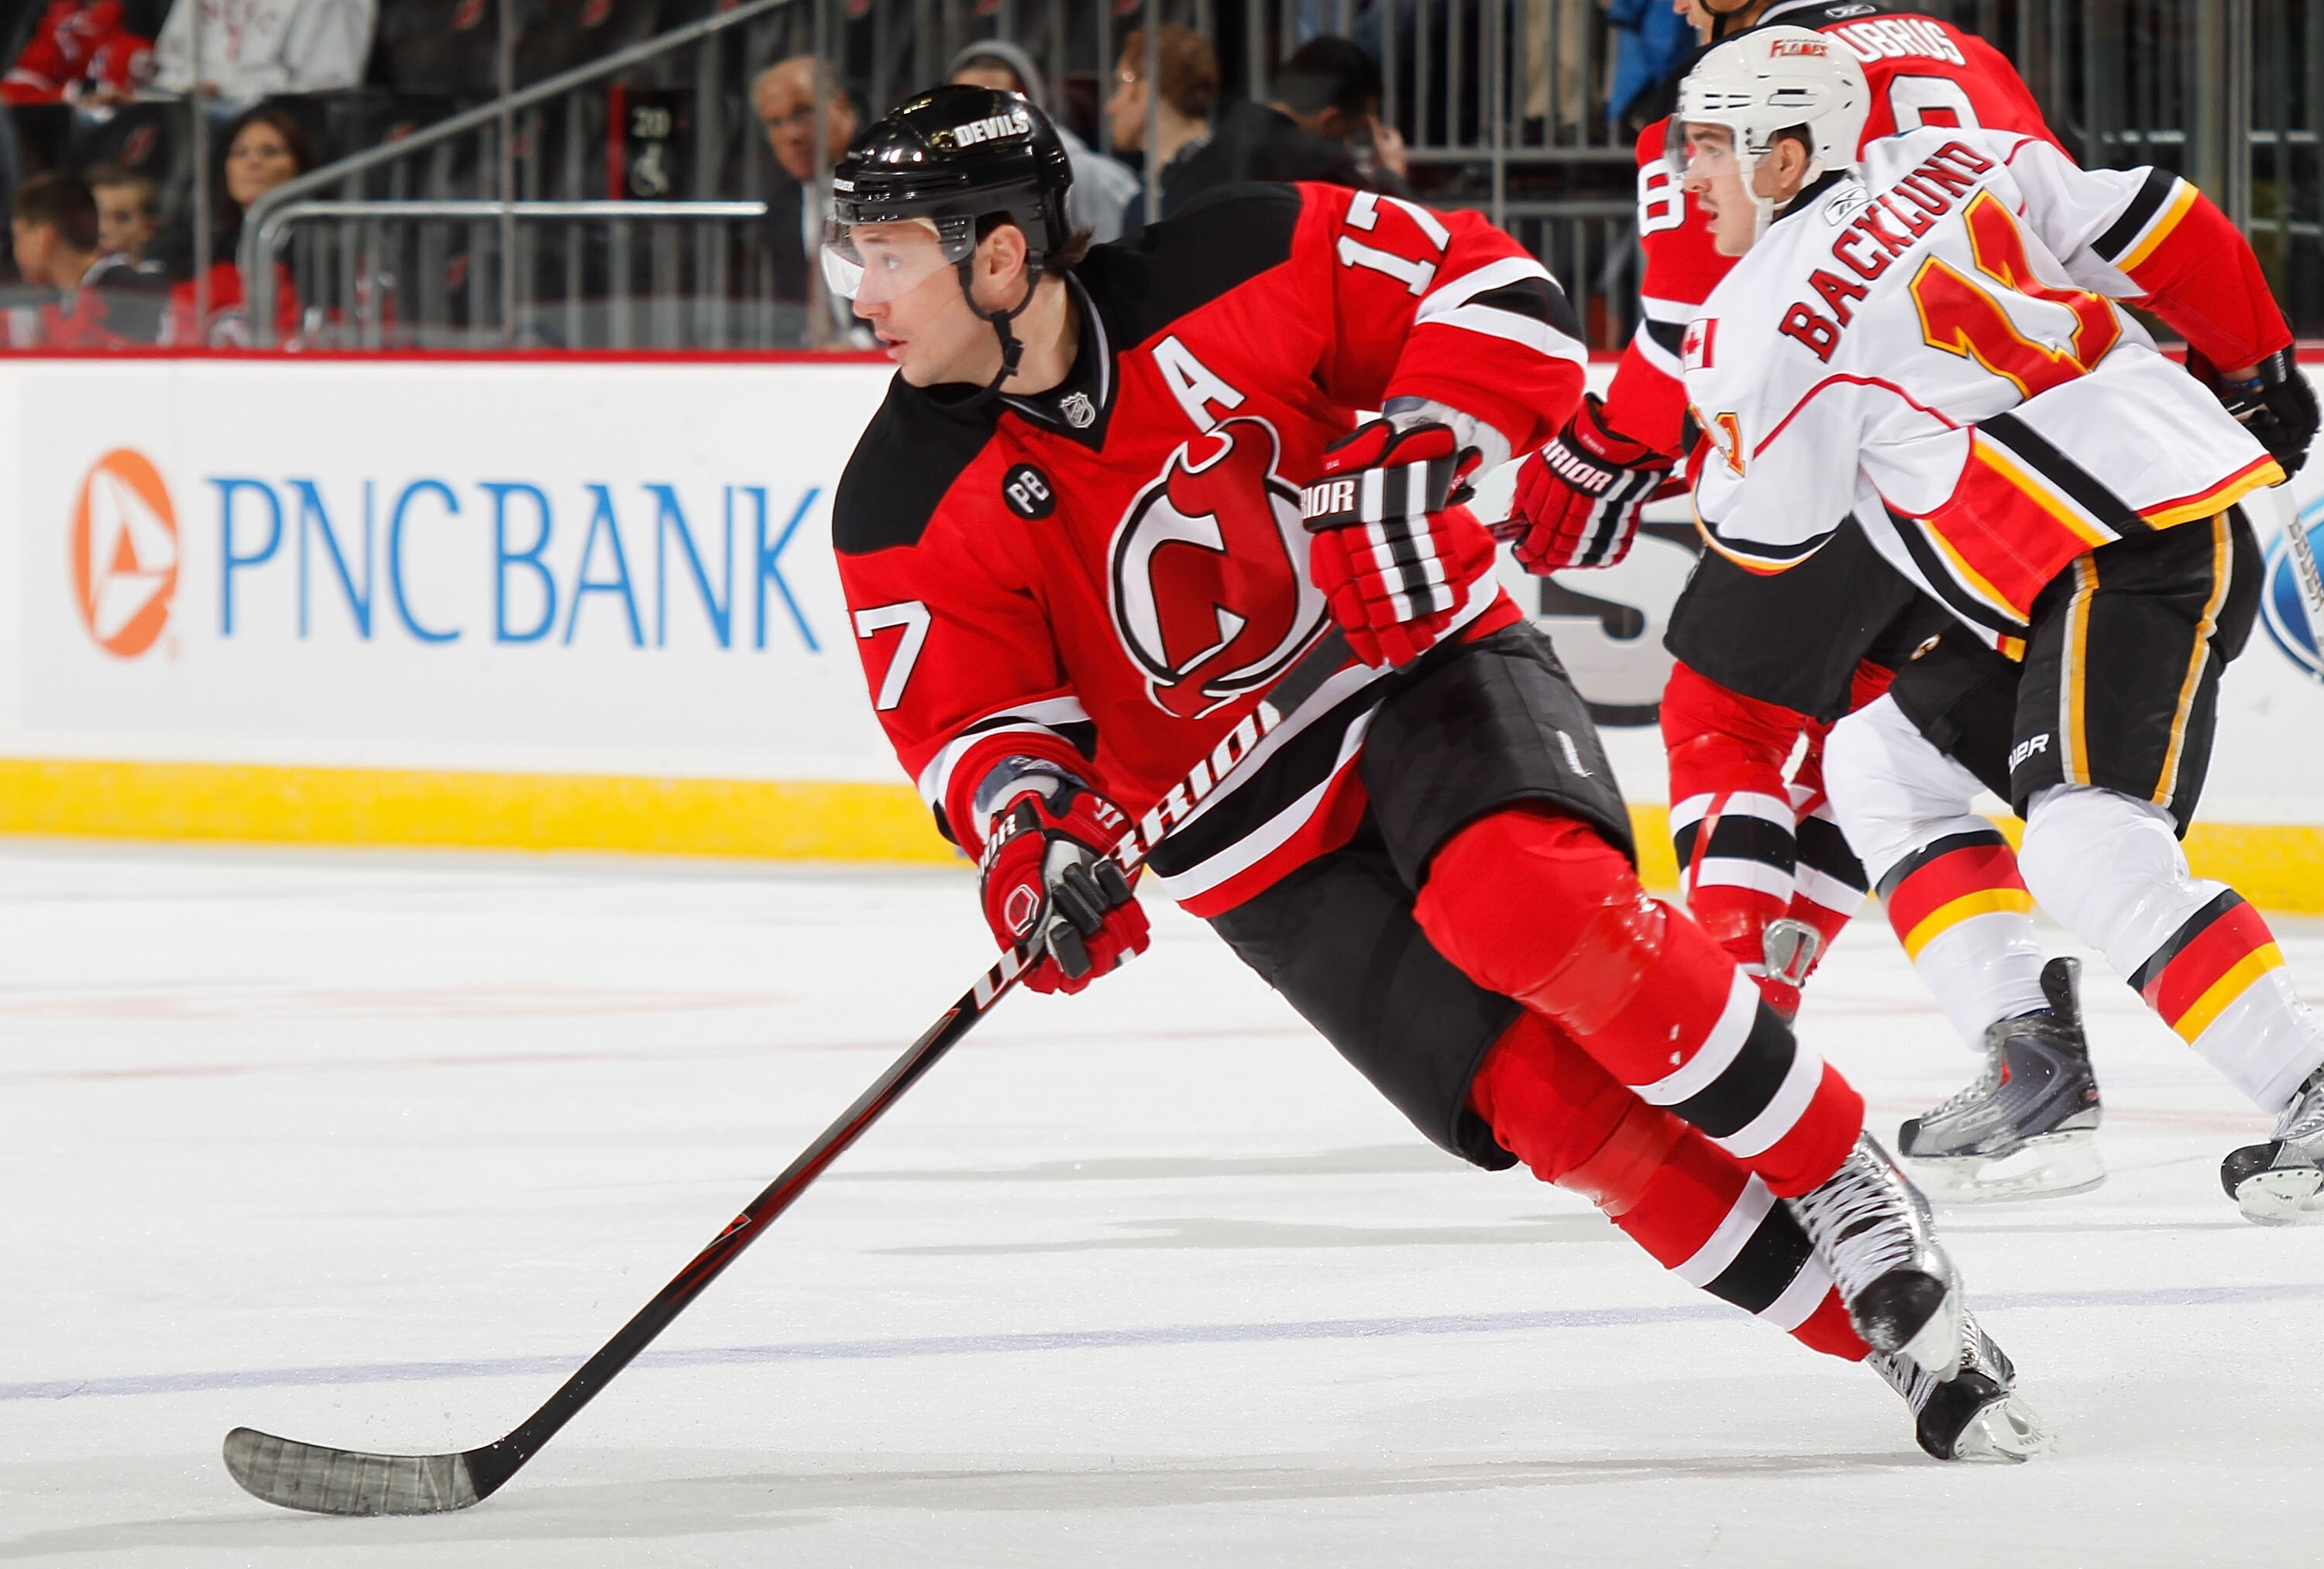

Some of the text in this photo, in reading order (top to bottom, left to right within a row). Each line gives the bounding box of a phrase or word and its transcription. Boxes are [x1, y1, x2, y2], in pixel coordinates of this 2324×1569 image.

[1824, 18, 1966, 66] UBRUS
[954, 111, 1030, 148] DEVILS
[1336, 190, 1452, 297] 17
[1778, 140, 1996, 364] BACKLUND
[1150, 334, 1246, 434] A
[1006, 469, 1050, 514] PB
[1300, 479, 1356, 520] IOR
[204, 477, 823, 654] PNC BANK
